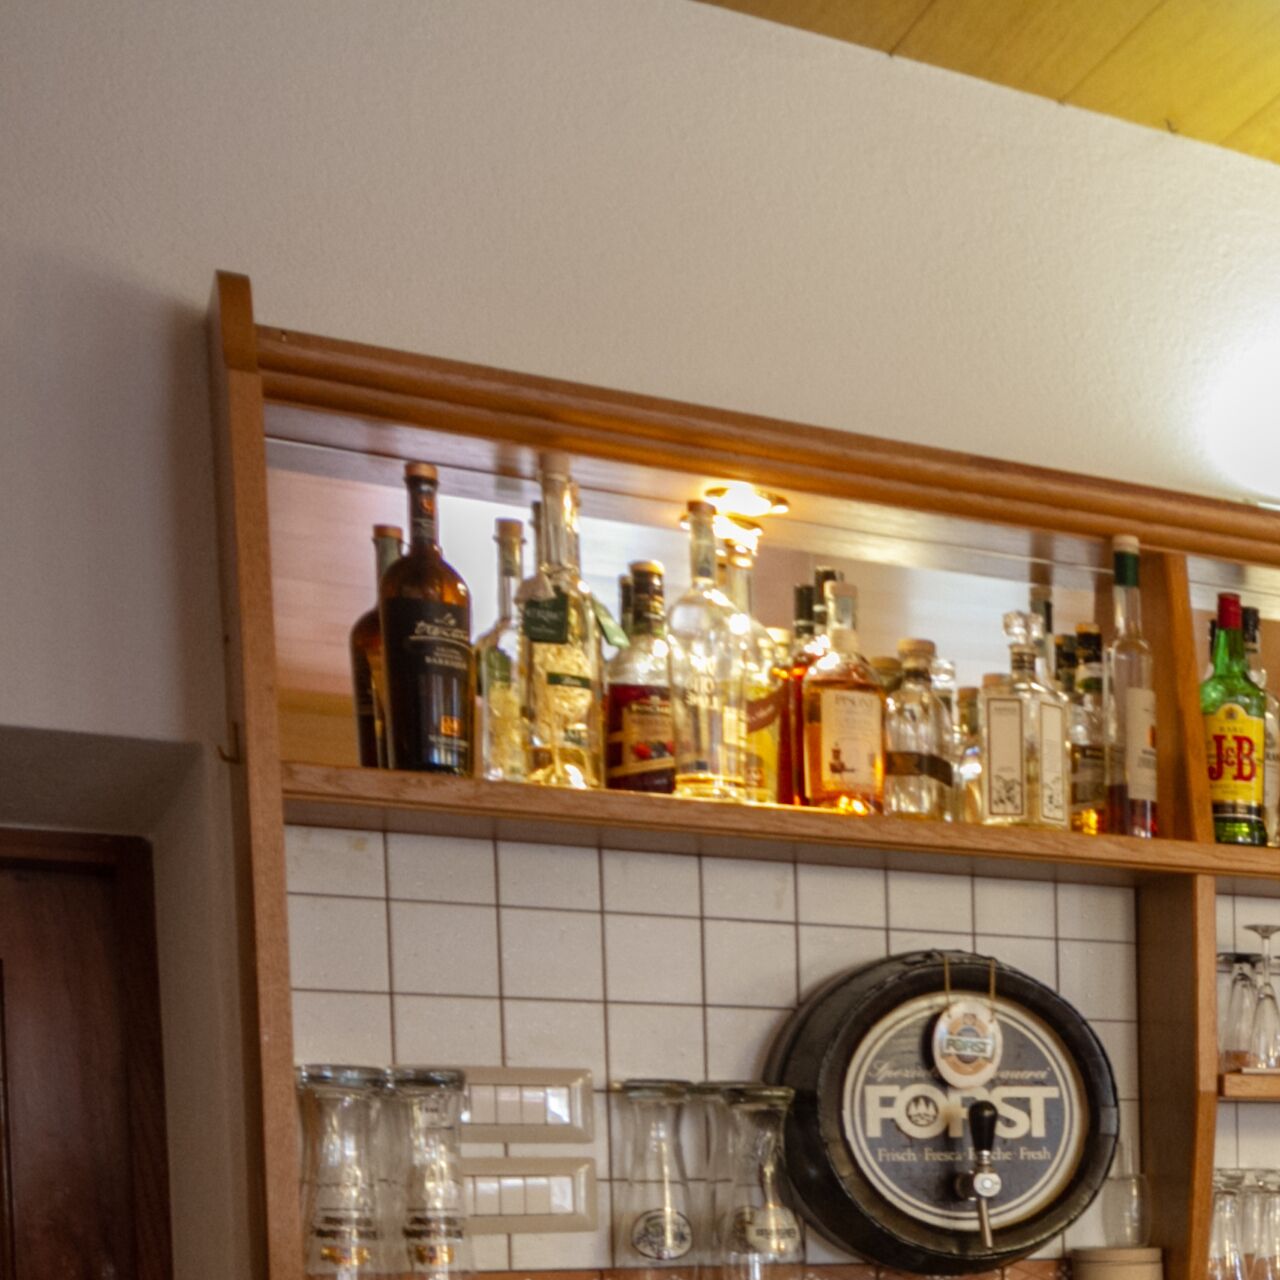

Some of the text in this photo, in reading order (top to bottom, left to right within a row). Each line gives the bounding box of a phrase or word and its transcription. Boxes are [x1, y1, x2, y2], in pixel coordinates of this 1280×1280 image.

[1208, 733, 1257, 782] J&B
[864, 1083, 1061, 1140] FORST
[1019, 1148, 1051, 1161] Fresh
